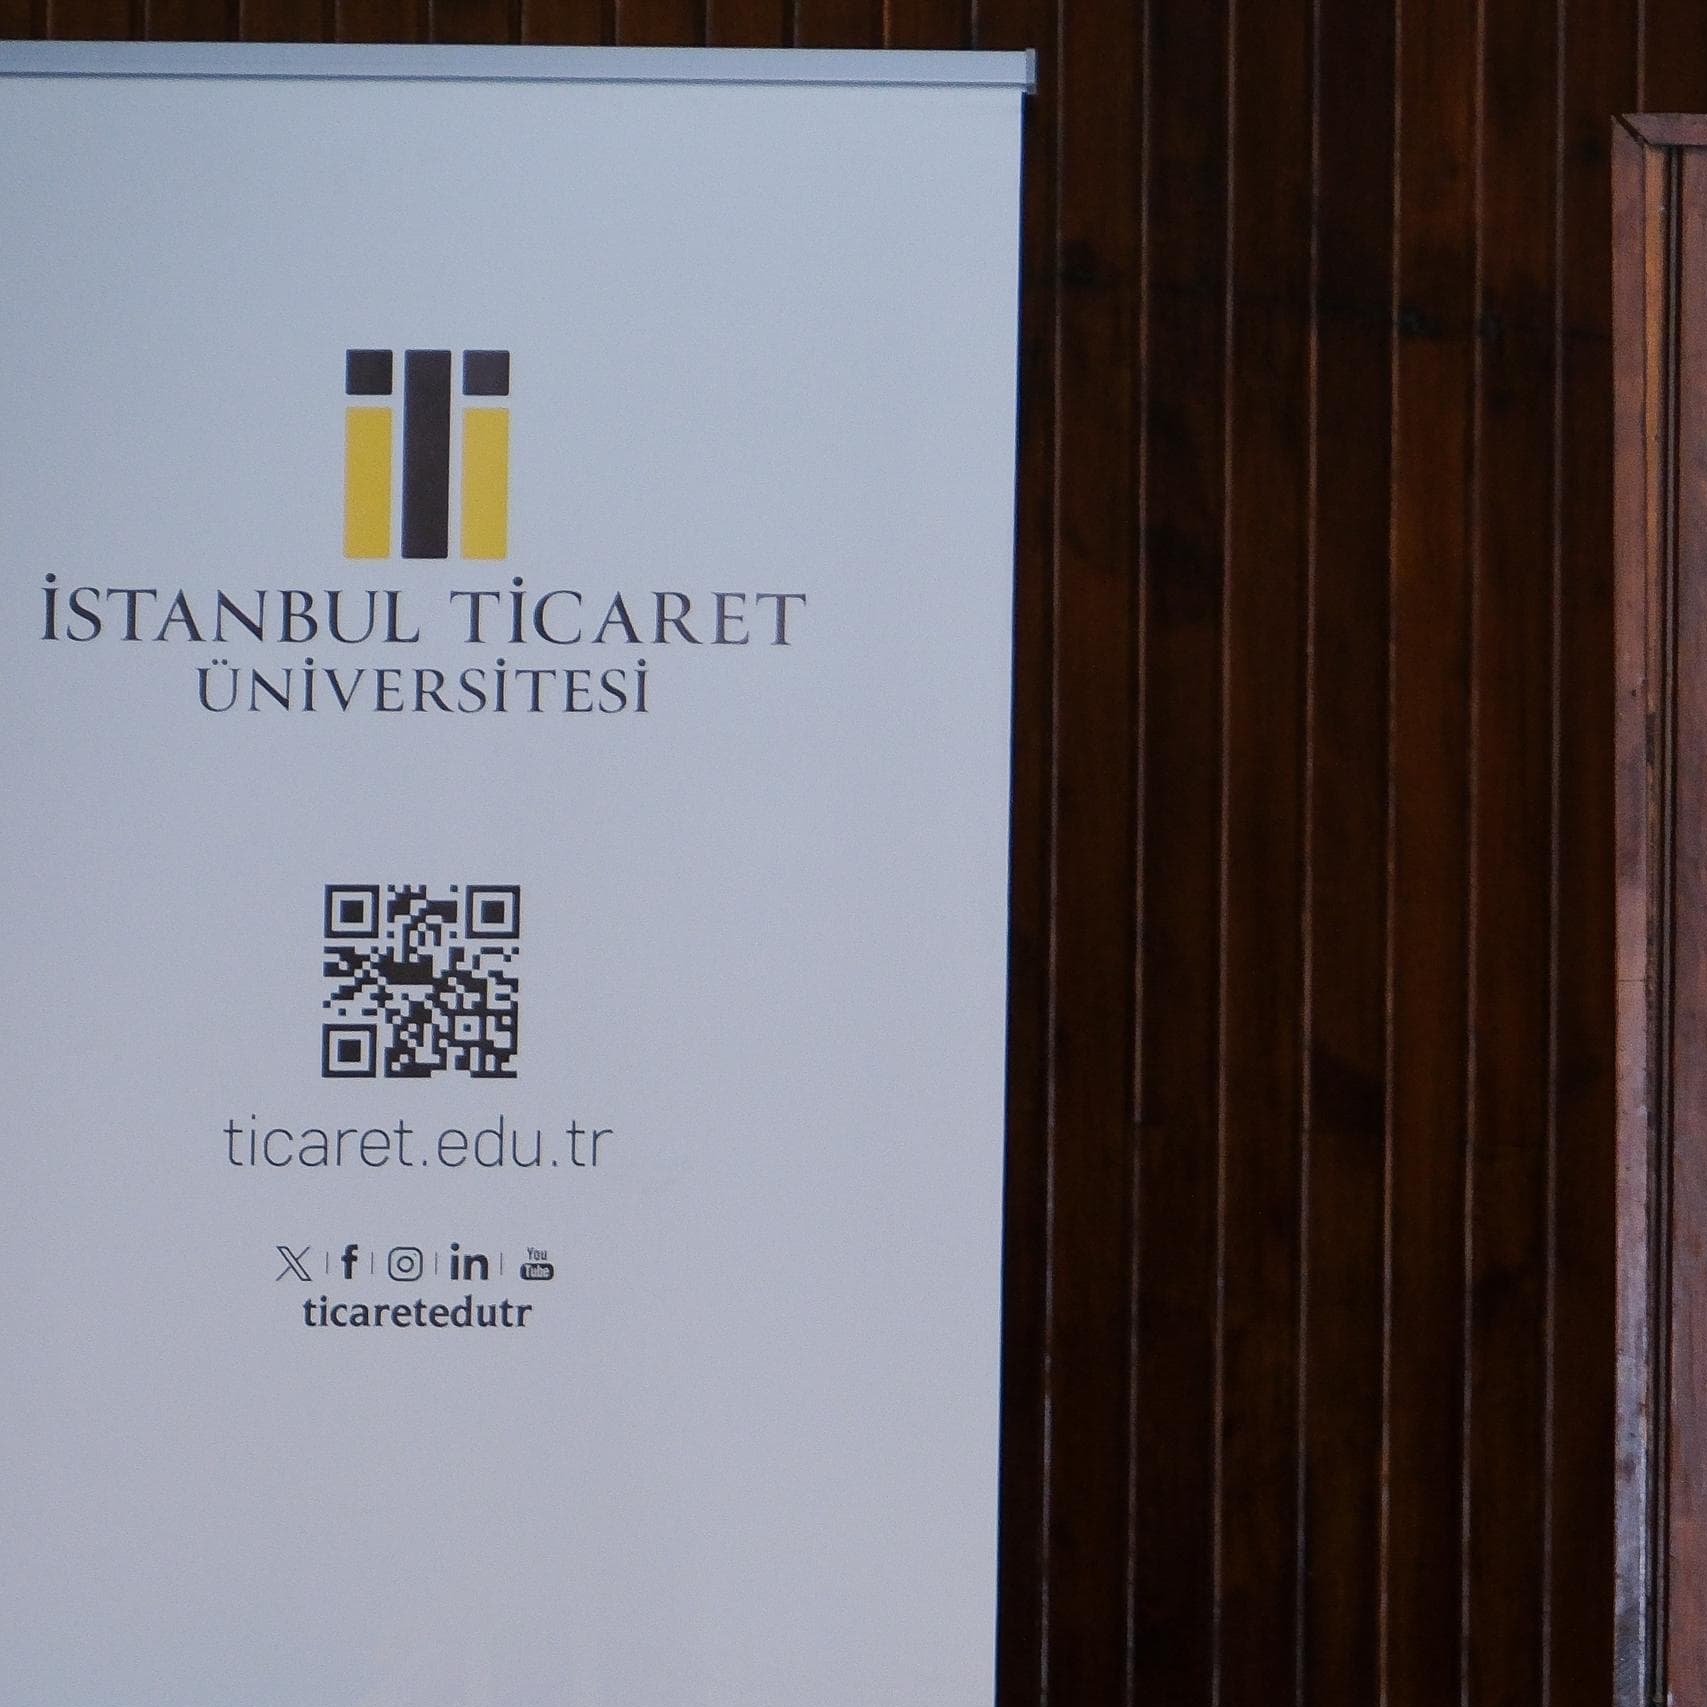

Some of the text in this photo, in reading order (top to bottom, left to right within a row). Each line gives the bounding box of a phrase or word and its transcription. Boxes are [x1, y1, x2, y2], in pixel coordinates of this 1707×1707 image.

[40, 572, 807, 647] İSTANBUL TİCARET
[196, 657, 650, 714] ÜNİVERSİTESİ
[222, 1113, 613, 1168] ticaret.edu.tr
[302, 1294, 533, 1328] ticaretedutr
